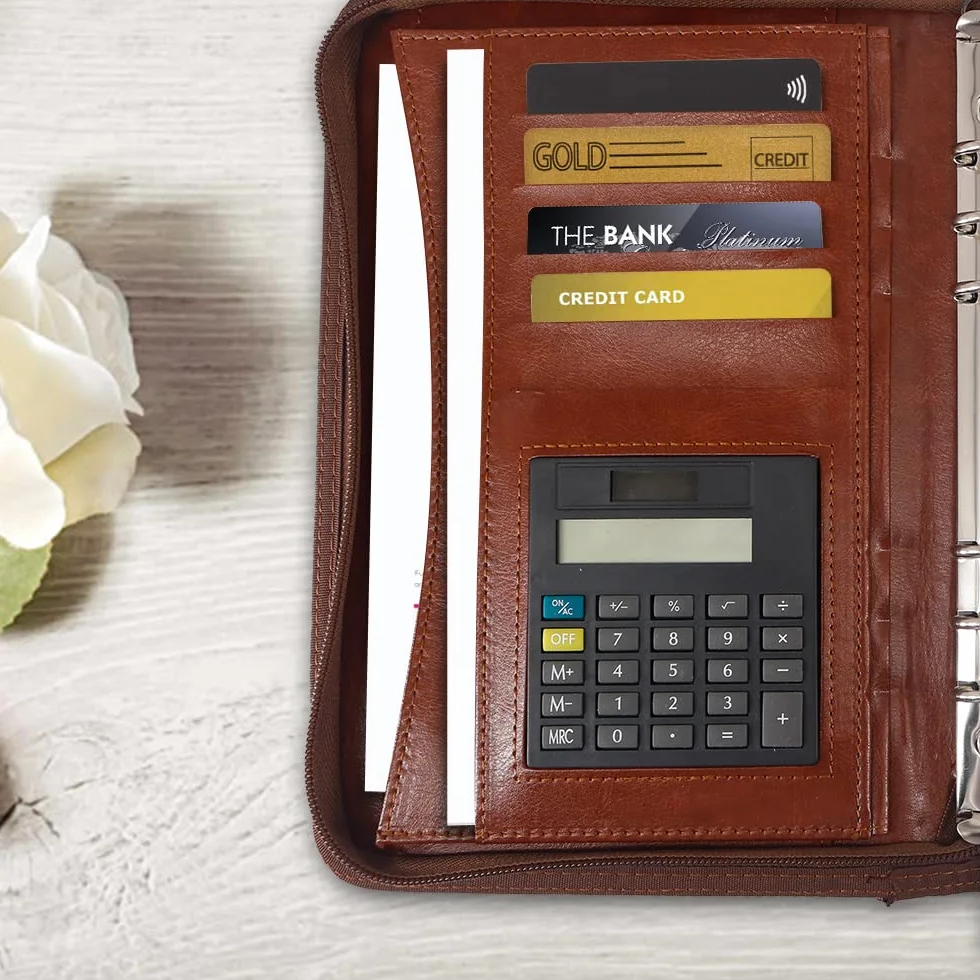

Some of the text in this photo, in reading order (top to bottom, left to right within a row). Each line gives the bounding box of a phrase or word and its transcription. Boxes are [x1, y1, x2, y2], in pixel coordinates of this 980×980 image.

[532, 141, 608, 172] GOLD
[754, 152, 809, 168] CREDIT
[551, 224, 673, 246] THE BANK
[696, 221, 804, 250] Platinum
[558, 290, 685, 306] CREDIT CARD
[550, 632, 576, 646] OFF
[613, 632, 623, 647] 7
[668, 631, 679, 646] 8
[723, 631, 733, 646] 9
[550, 663, 575, 681] M+
[612, 663, 623, 678] 4
[668, 663, 678, 677] 5
[722, 663, 733, 678] 6
[549, 695, 573, 713] M-
[614, 696, 622, 711] 1
[668, 695, 678, 710] 2
[723, 695, 733, 710] 3
[548, 728, 574, 745] MRC
[612, 728, 623, 744] 0
